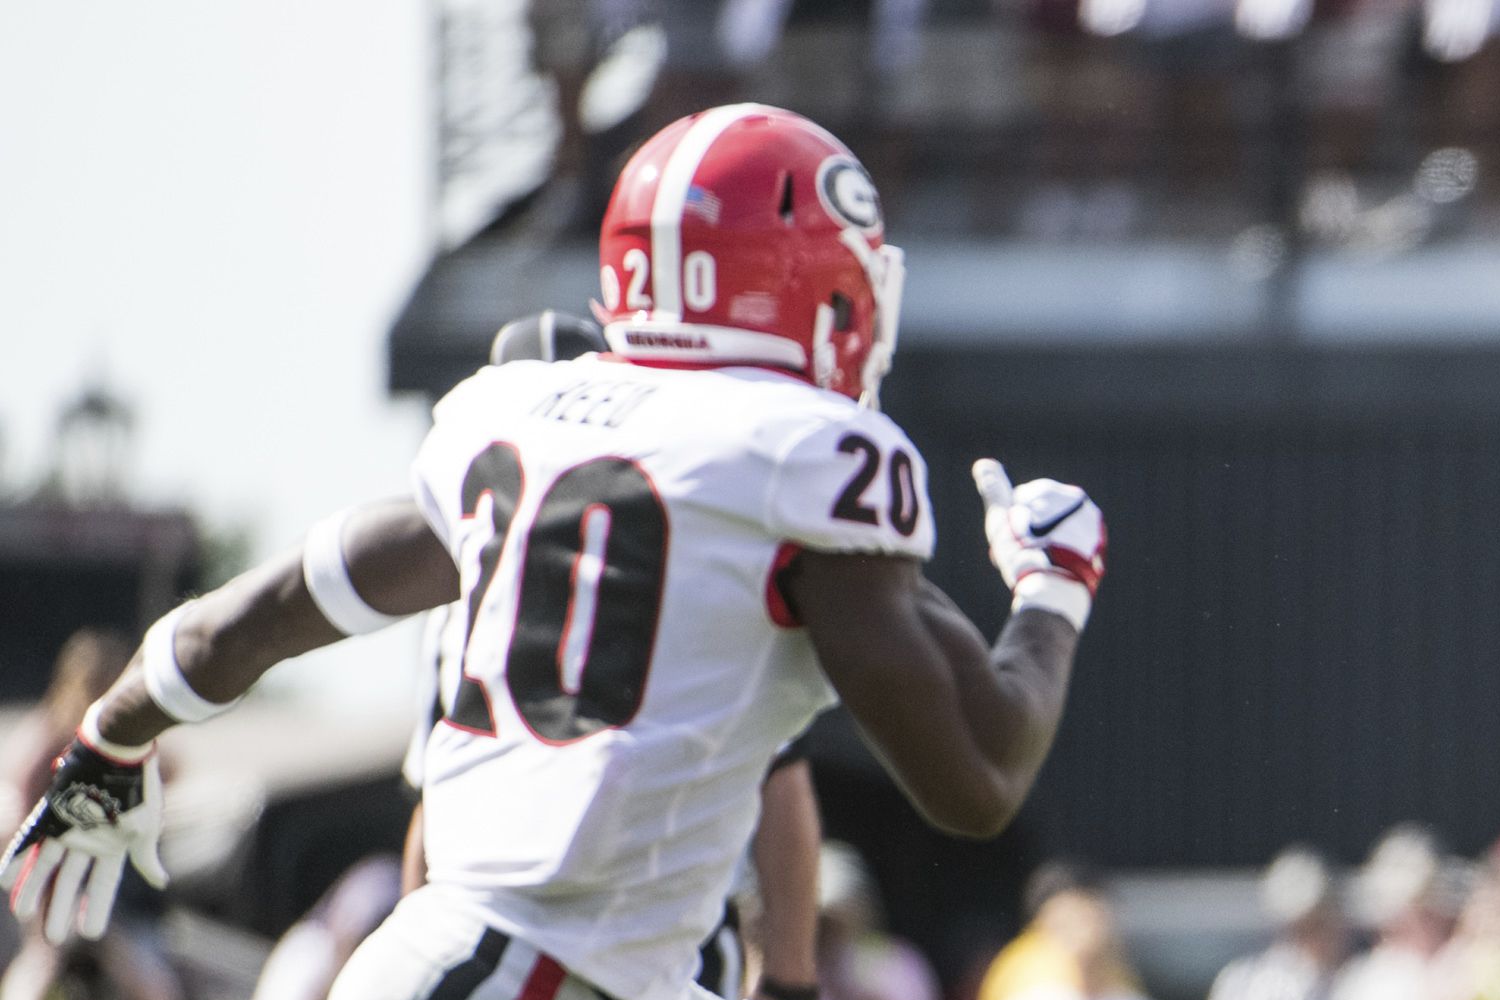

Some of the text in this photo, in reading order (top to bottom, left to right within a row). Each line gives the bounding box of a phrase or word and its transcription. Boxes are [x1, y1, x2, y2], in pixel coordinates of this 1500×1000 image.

[531, 378, 659, 429] REED
[830, 432, 919, 537] 20
[443, 440, 670, 747] 20
